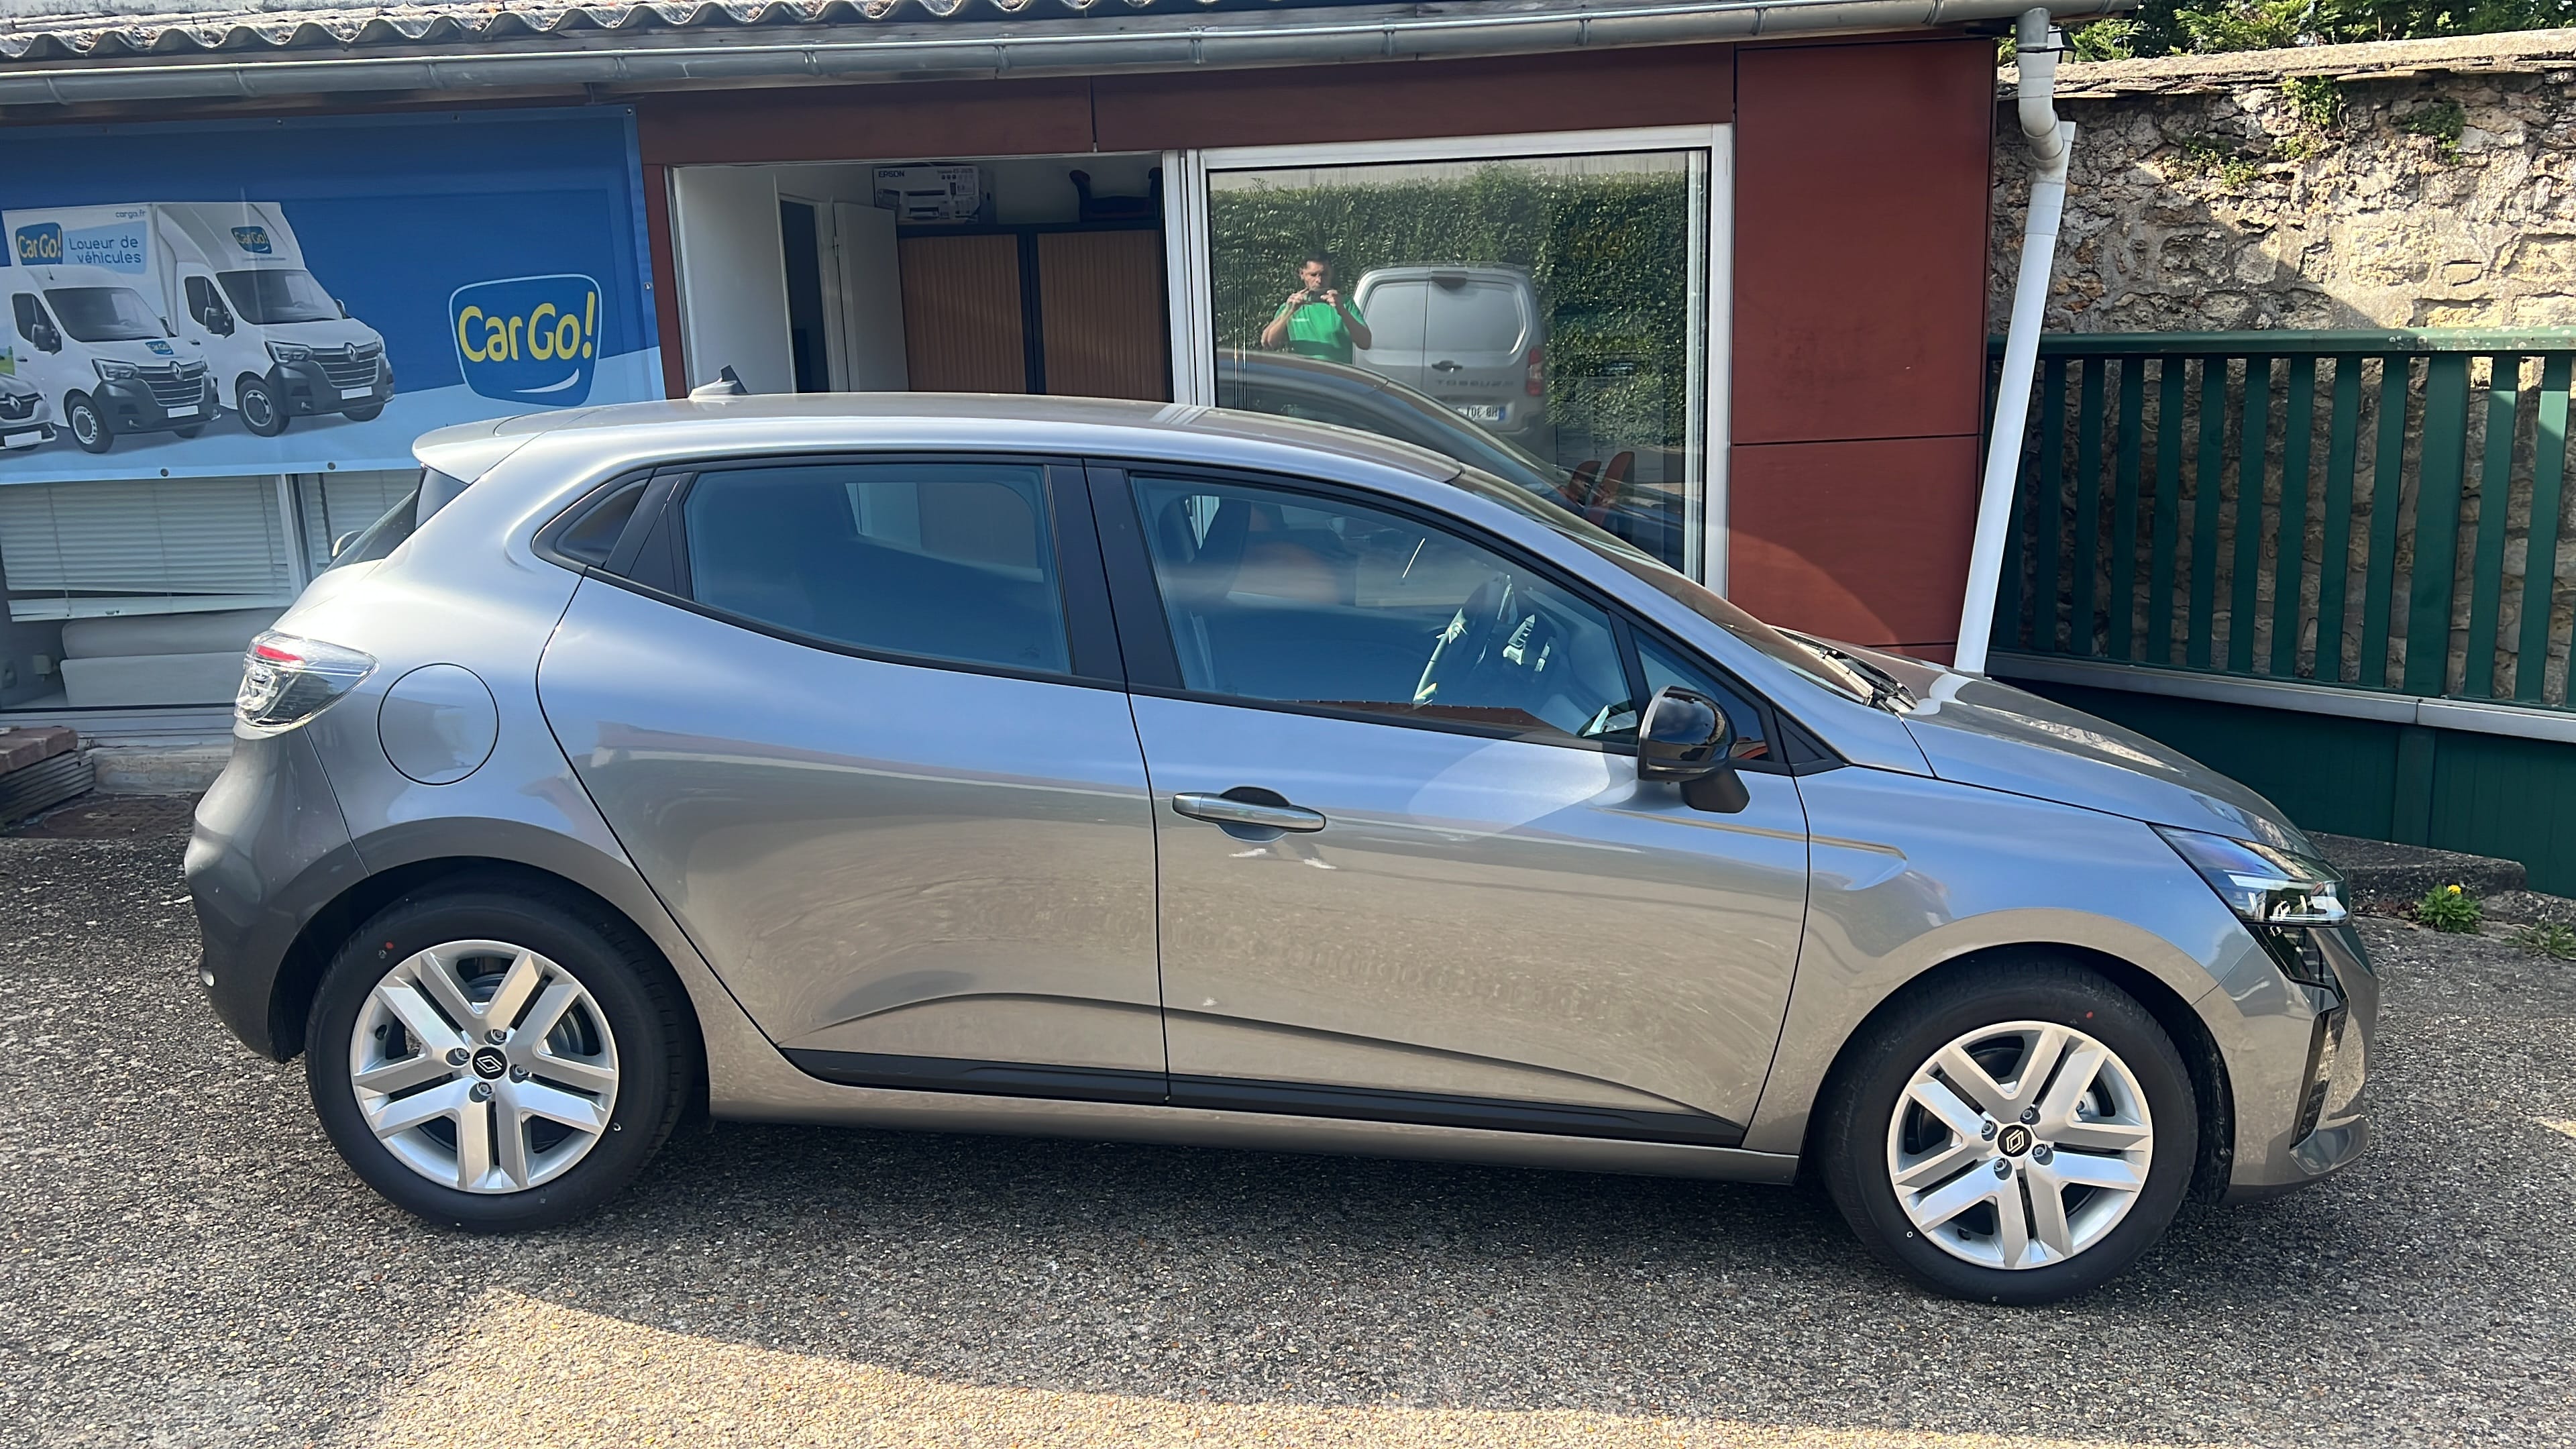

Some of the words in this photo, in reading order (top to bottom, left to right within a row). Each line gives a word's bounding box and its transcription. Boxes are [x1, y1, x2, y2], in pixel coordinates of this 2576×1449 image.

[878, 170, 905, 178] EPSON
[68, 237, 115, 250] Loueur
[120, 235, 139, 249] de
[76, 250, 142, 264] véhicules
